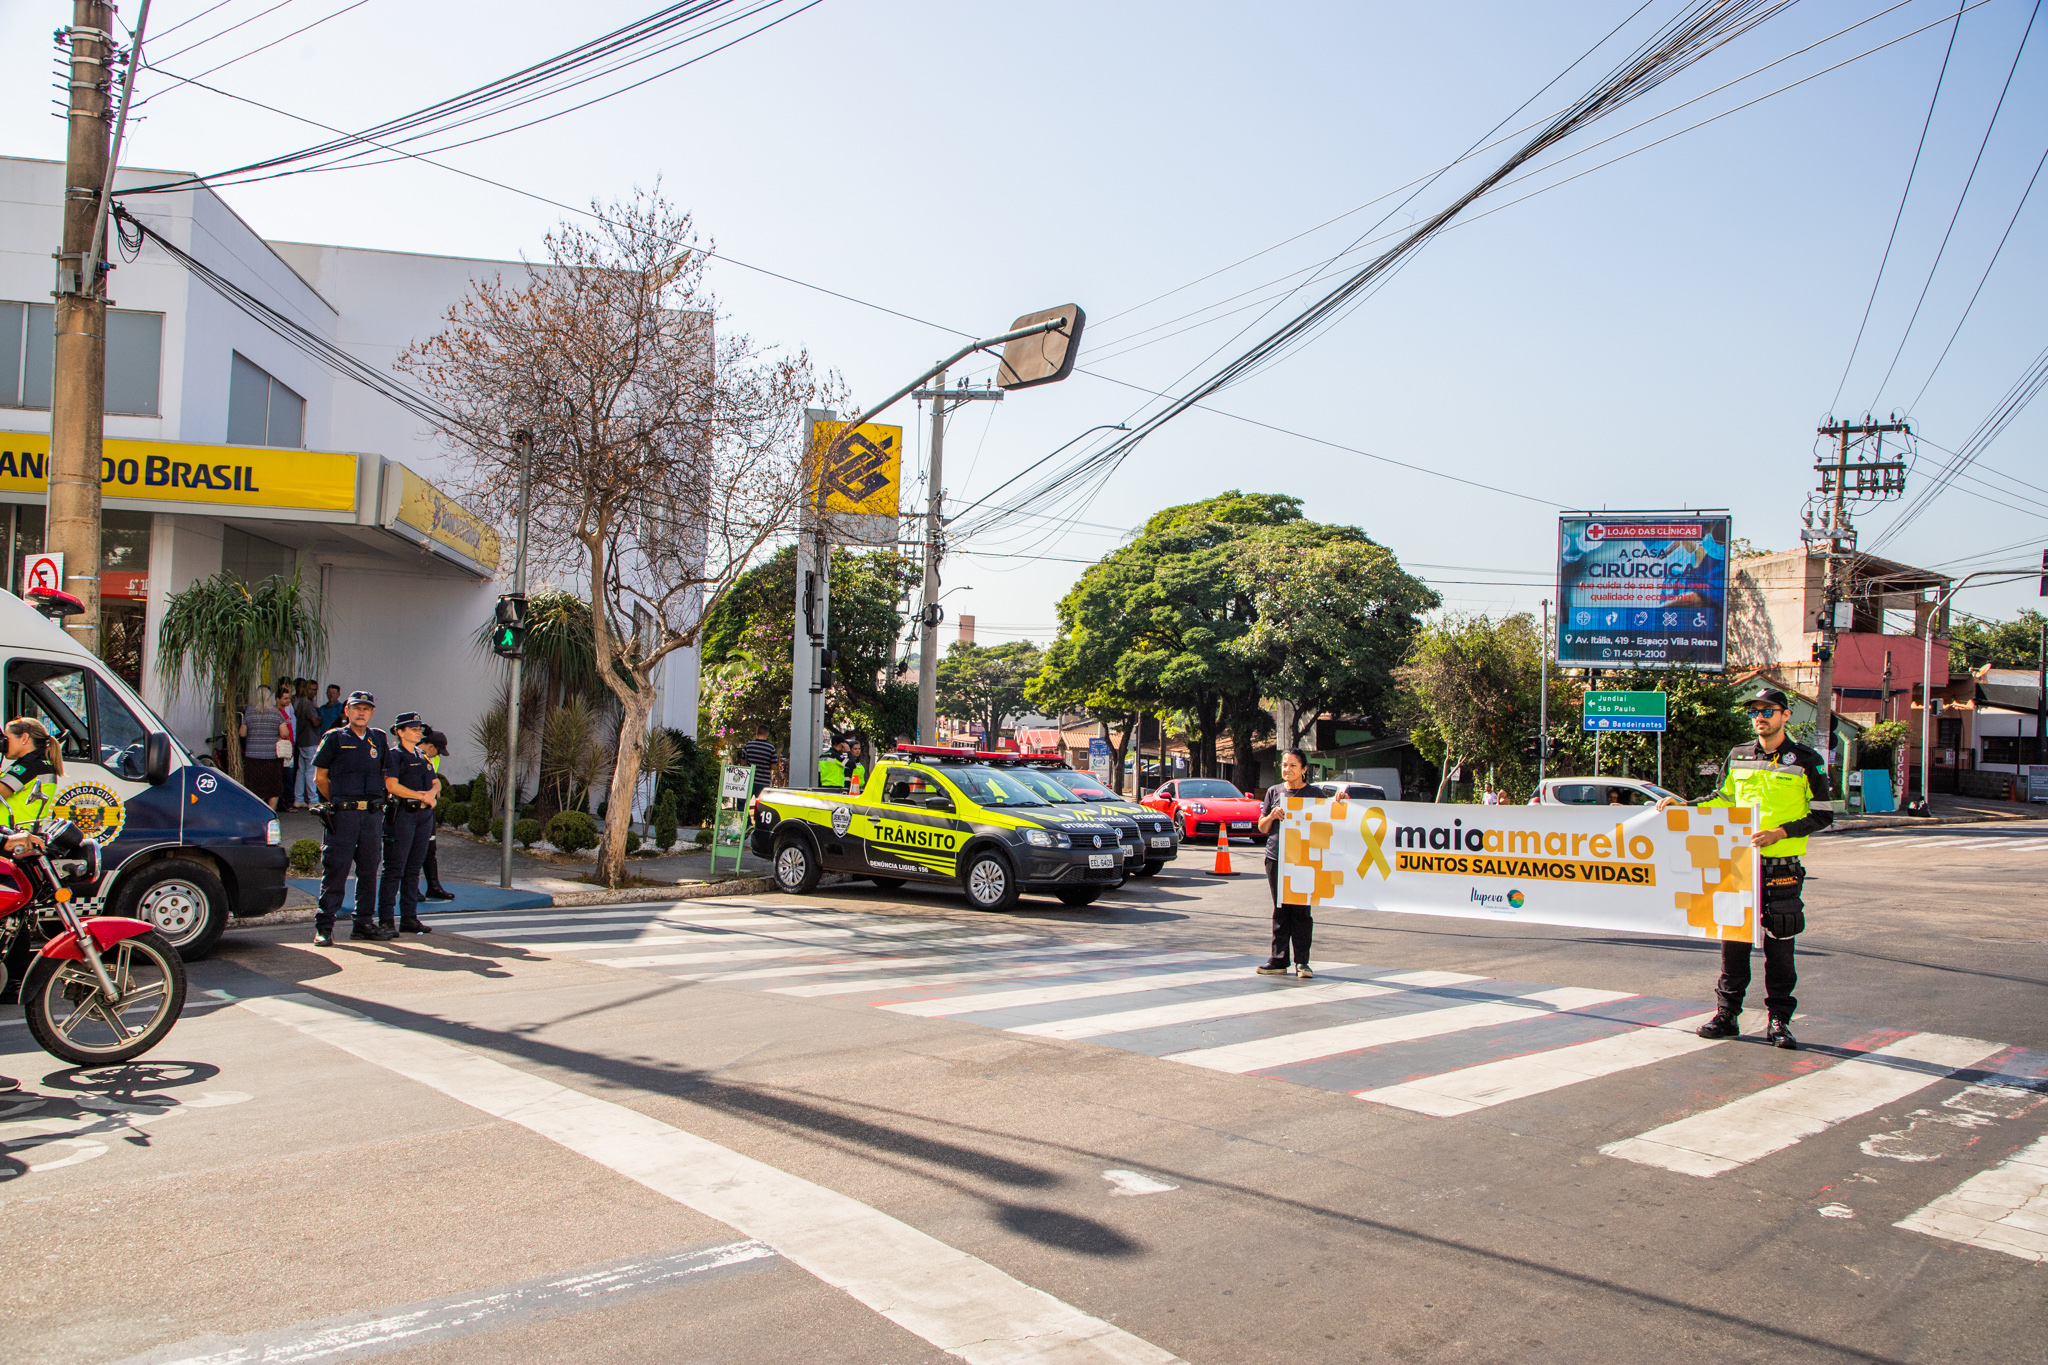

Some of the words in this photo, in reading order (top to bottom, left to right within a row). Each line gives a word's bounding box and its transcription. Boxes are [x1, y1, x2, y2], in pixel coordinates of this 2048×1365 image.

[145, 455, 260, 492] BRASIL
[1607, 525, 1636, 536] LOJÃO
[1638, 527, 1656, 536] DAS
[1656, 525, 1697, 536] CLÍNICAS
[1619, 549, 1629, 558] A
[1631, 548, 1667, 559] CASA
[1587, 558, 1697, 578] CIRÚRGICA
[1596, 581, 1622, 590] cuida
[1623, 581, 1636, 590] de
[1638, 582, 1654, 590] sua
[1656, 580, 1685, 590] saúde
[1590, 592, 1635, 602] qualidade
[1575, 636, 1589, 644] Av.
[1614, 636, 1629, 645] 419
[1636, 637, 1669, 648] Espaço
[1670, 637, 1689, 646] Villa
[1690, 638, 1718, 647] Roma
[1613, 649, 1621, 658] 11
[1597, 694, 1627, 702] Jundiaí
[1612, 721, 1663, 729] Bandeirantes
[199, 778, 214, 788] 25
[59, 786, 95, 806] GUARDA
[96, 789, 114, 806] CIVIL
[760, 810, 773, 824] 19
[873, 824, 956, 850] TRÂNSITO
[870, 860, 898, 870] DENÚNCIA
[898, 863, 918, 872] LIGUE:
[1399, 855, 1469, 874] JUNTOS
[1471, 858, 1577, 880] SALVAMOS
[1579, 864, 1650, 884] VIDAS!
[1470, 886, 1504, 906] Itupeva
